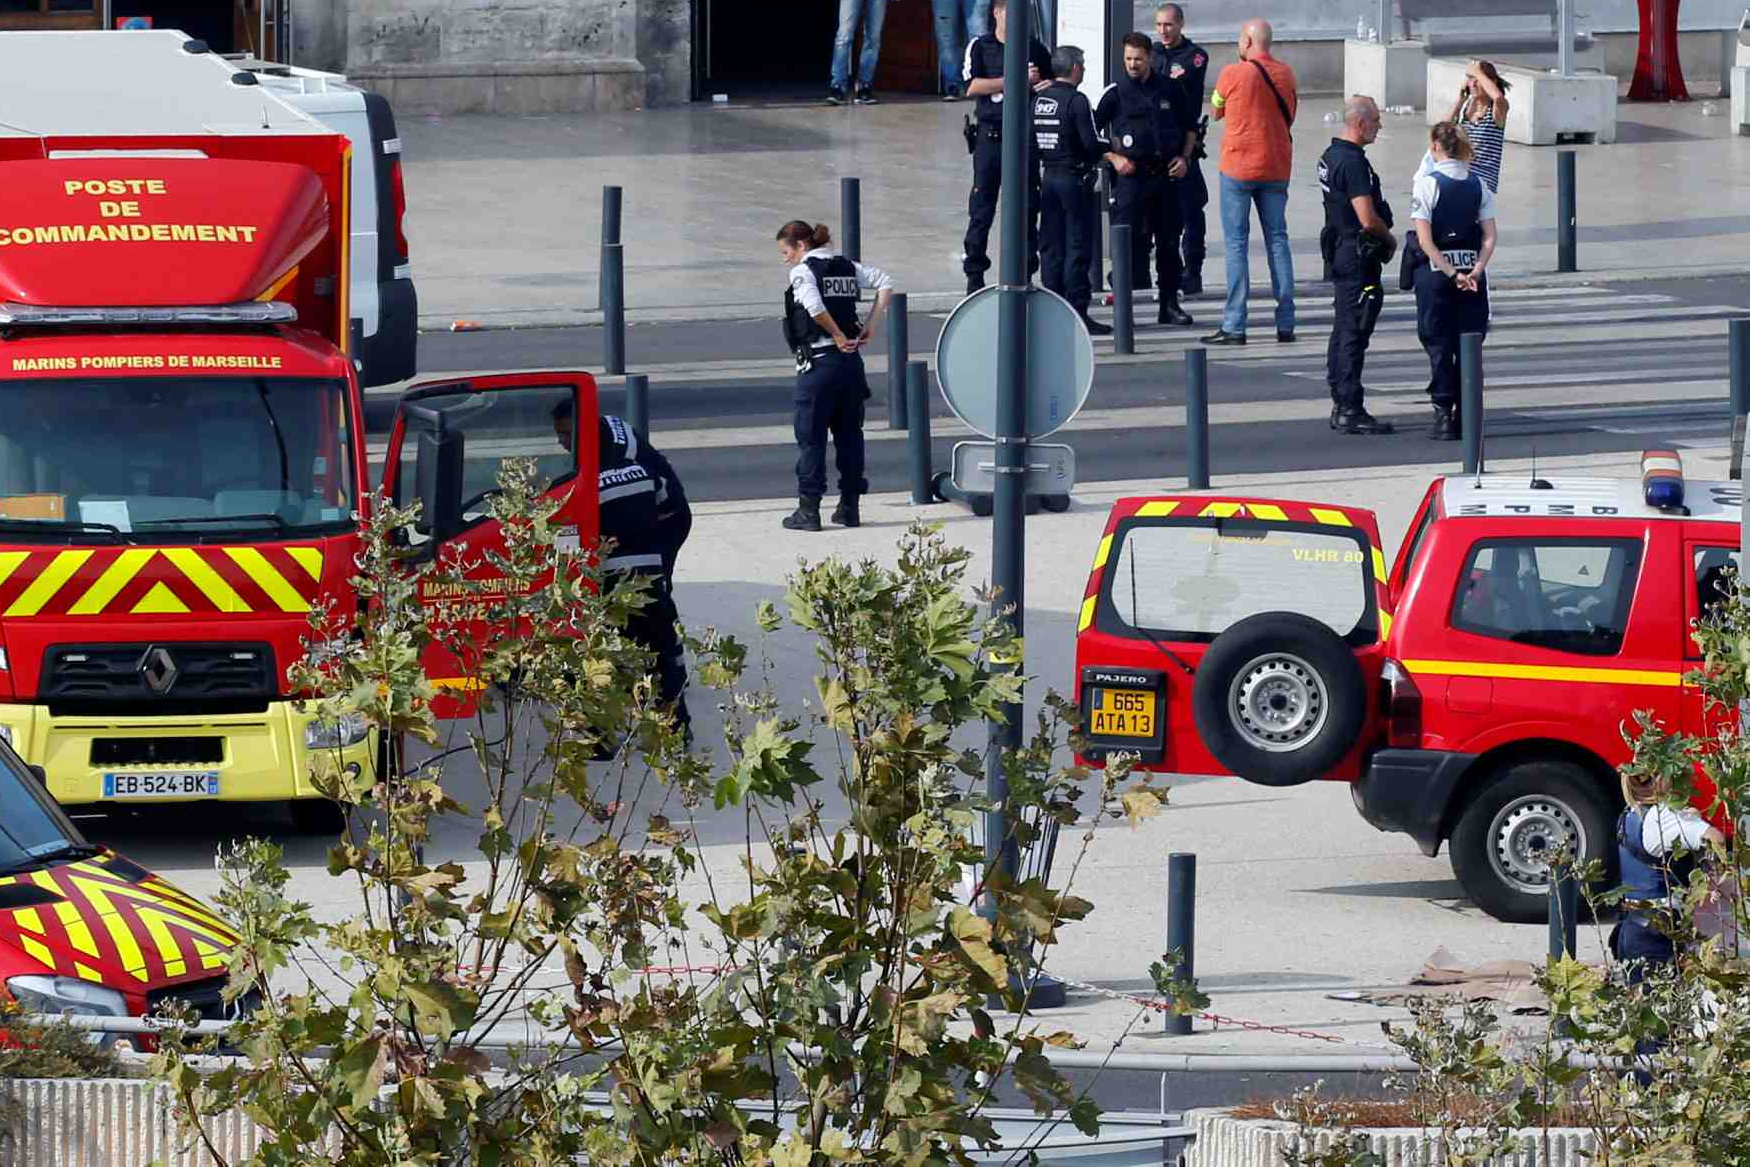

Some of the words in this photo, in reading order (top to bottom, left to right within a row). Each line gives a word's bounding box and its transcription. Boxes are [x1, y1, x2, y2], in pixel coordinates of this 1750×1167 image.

[64, 180, 167, 195] POSTE
[100, 201, 141, 217] DE
[1434, 252, 1476, 267] OLICE
[13, 358, 76, 371] MARINS
[81, 356, 164, 369] POMPIERS
[168, 355, 189, 368] DE
[192, 355, 281, 369] MARSEILLE
[1292, 548, 1338, 562] VLHR
[1096, 674, 1147, 683] PAJERO
[1114, 693, 1145, 711] 665
[1096, 713, 1126, 731] ATA
[1131, 714, 1150, 732] 13
[115, 776, 206, 794] EB-524-BK
